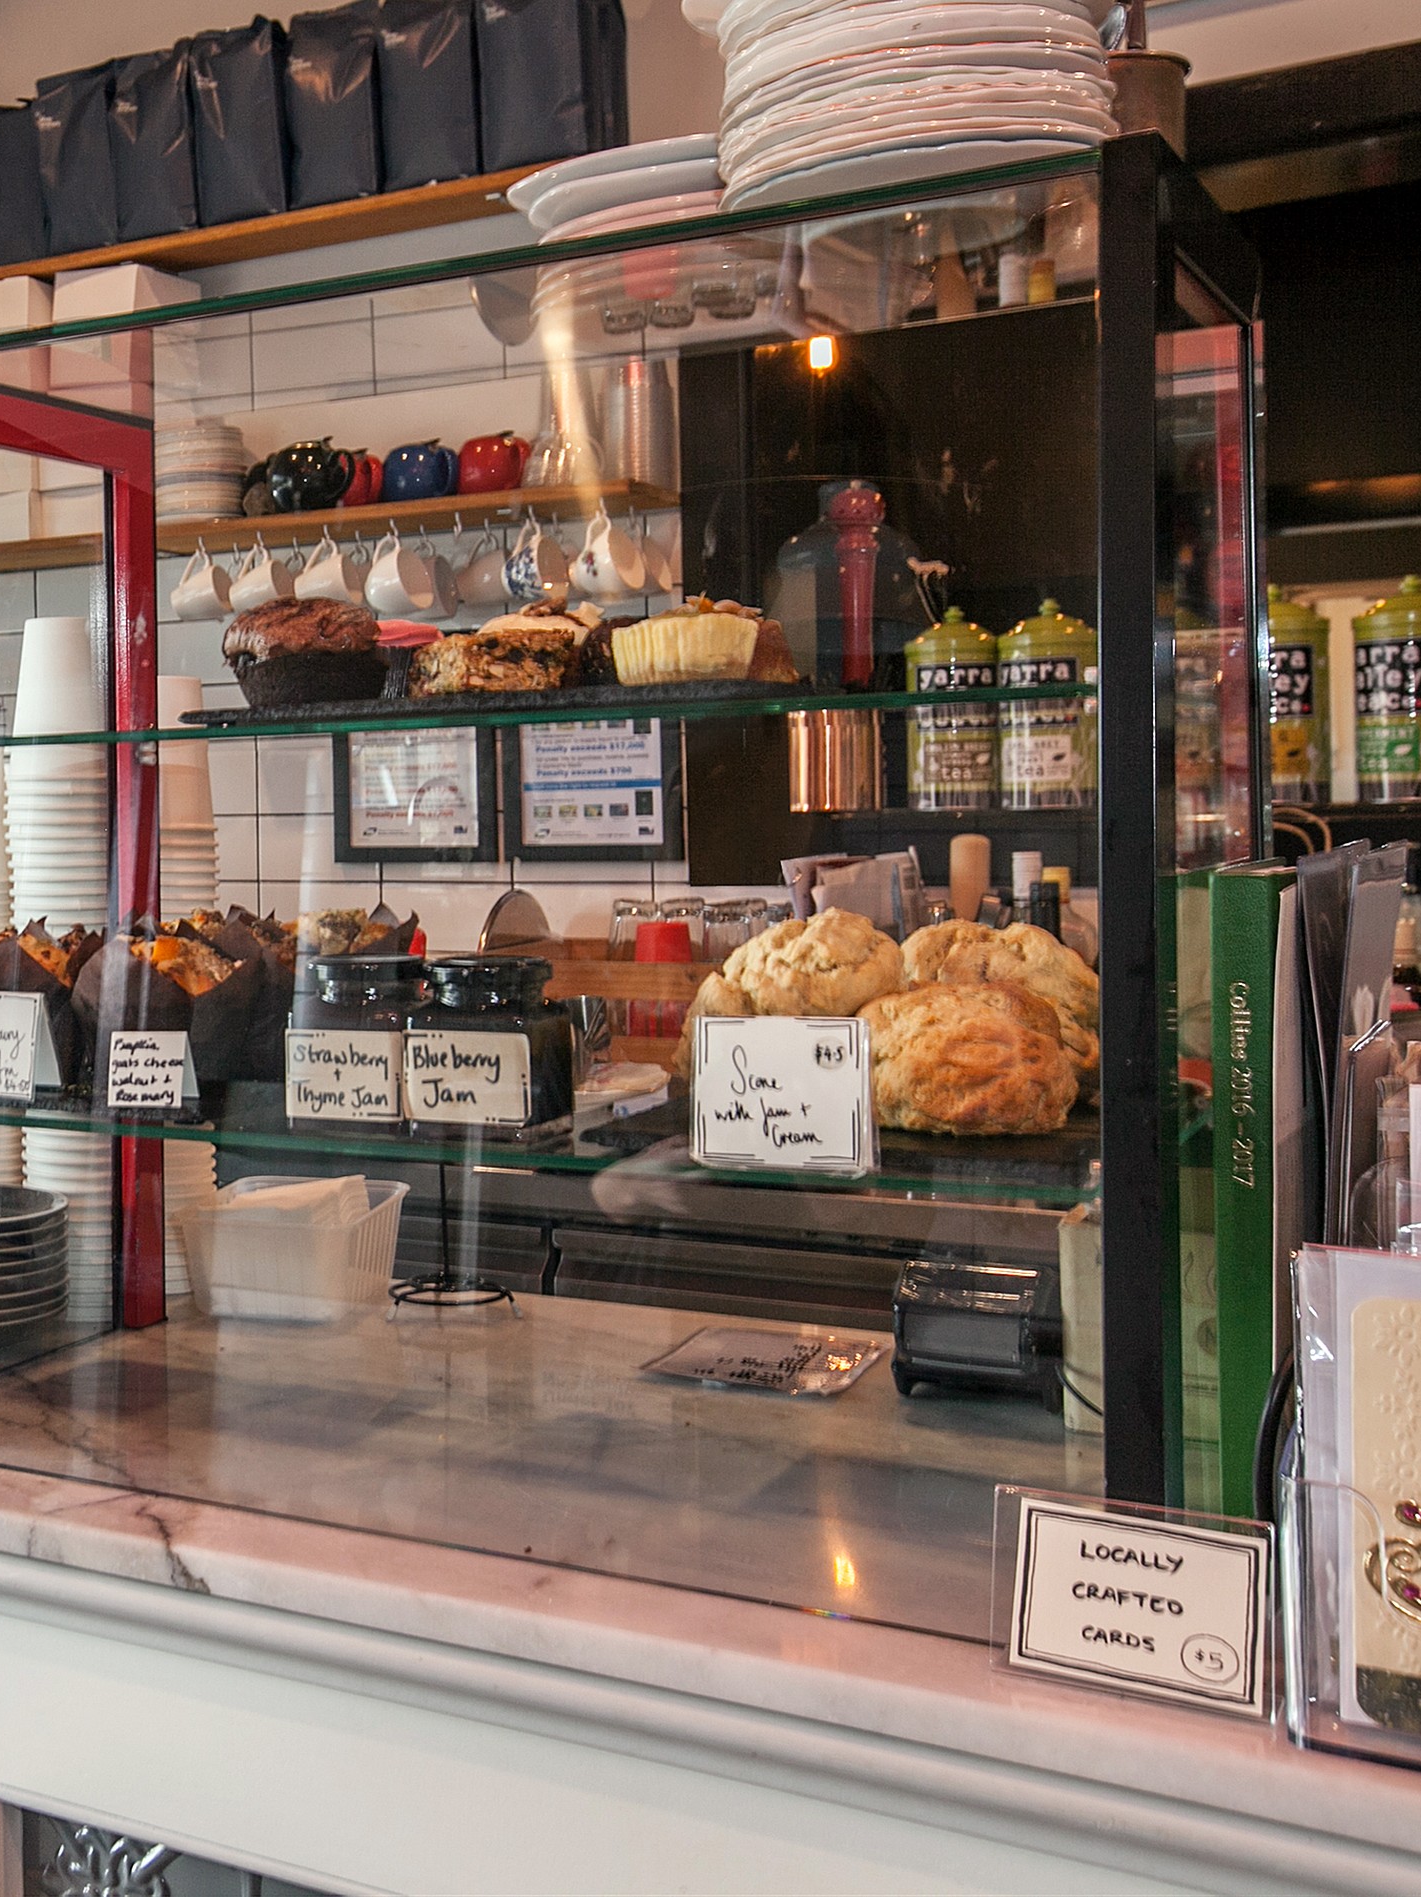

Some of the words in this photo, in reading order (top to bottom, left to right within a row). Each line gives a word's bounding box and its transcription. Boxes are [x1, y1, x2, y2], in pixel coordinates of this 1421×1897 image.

[919, 667, 993, 690] yarra
[1230, 981, 1252, 1061] Collins
[293, 1043, 389, 1081] Strawberry
[412, 1043, 501, 1084] Blueberry
[731, 1044, 782, 1095] Scone
[292, 1079, 345, 1113] Thyme
[351, 1085, 388, 1108] Jam
[422, 1078, 477, 1109] Jam
[1231, 1066, 1256, 1117] 2016
[714, 1100, 754, 1121] with
[772, 1124, 823, 1149] Cream
[1232, 1137, 1255, 1189] 2017
[1080, 1539, 1184, 1575] LOCALLY
[1072, 1581, 1184, 1616] CRAFTED
[1082, 1624, 1156, 1653] CARDS
[1194, 1648, 1224, 1672] $5
